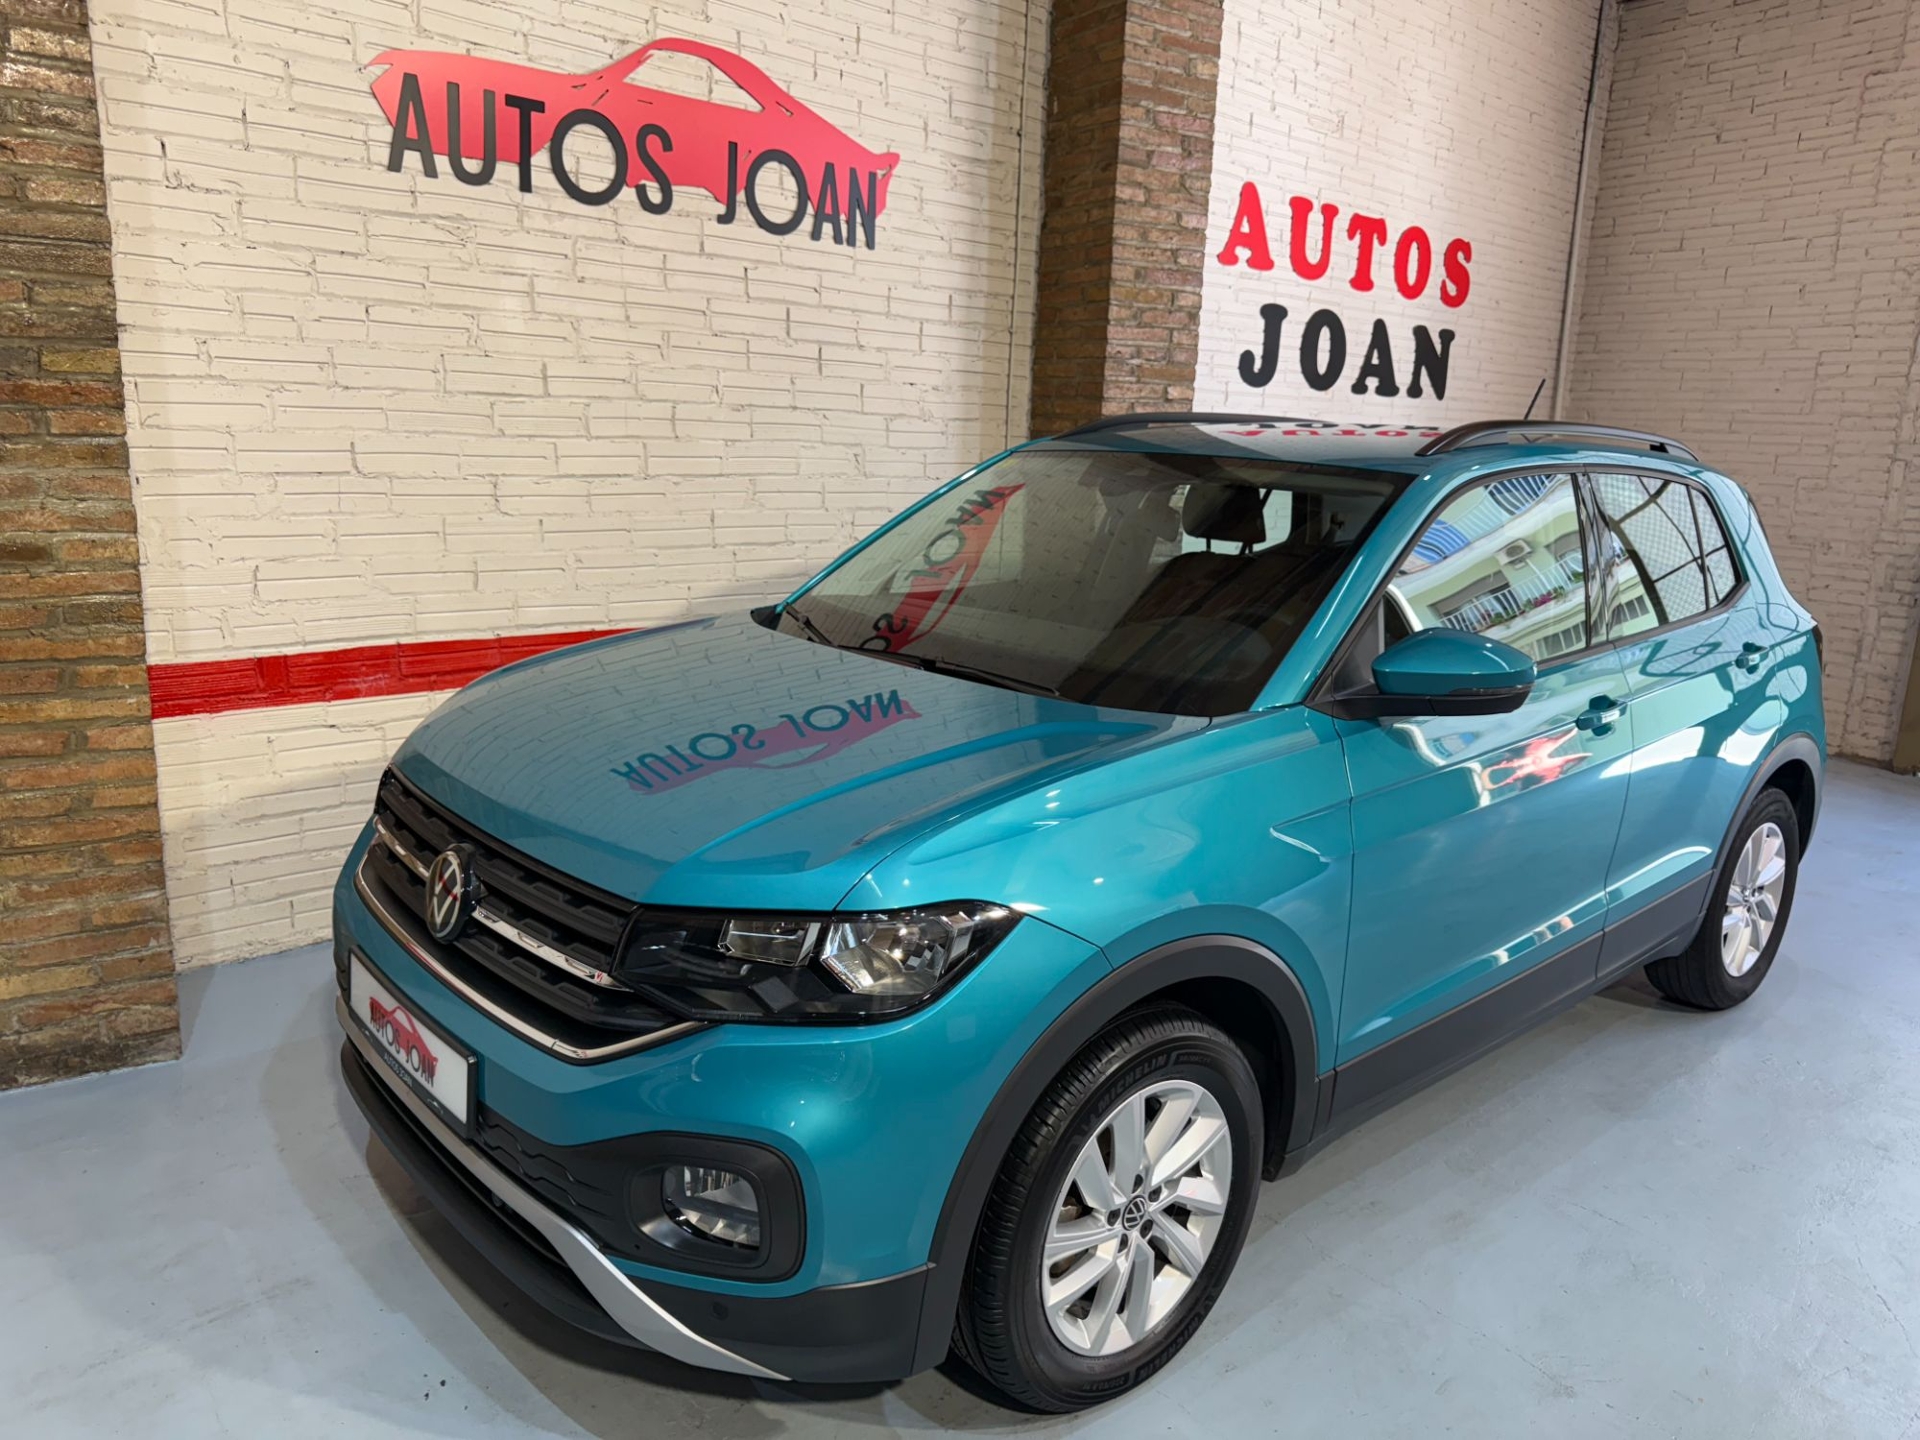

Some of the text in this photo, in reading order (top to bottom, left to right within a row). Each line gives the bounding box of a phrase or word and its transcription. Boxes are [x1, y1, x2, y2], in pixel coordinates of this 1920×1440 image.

[388, 72, 877, 250] AUTOS JOAN
[1217, 181, 1472, 308] AUTOS
[1238, 303, 1455, 401] JOAN
[1097, 1054, 1168, 1112] MICHELIN
